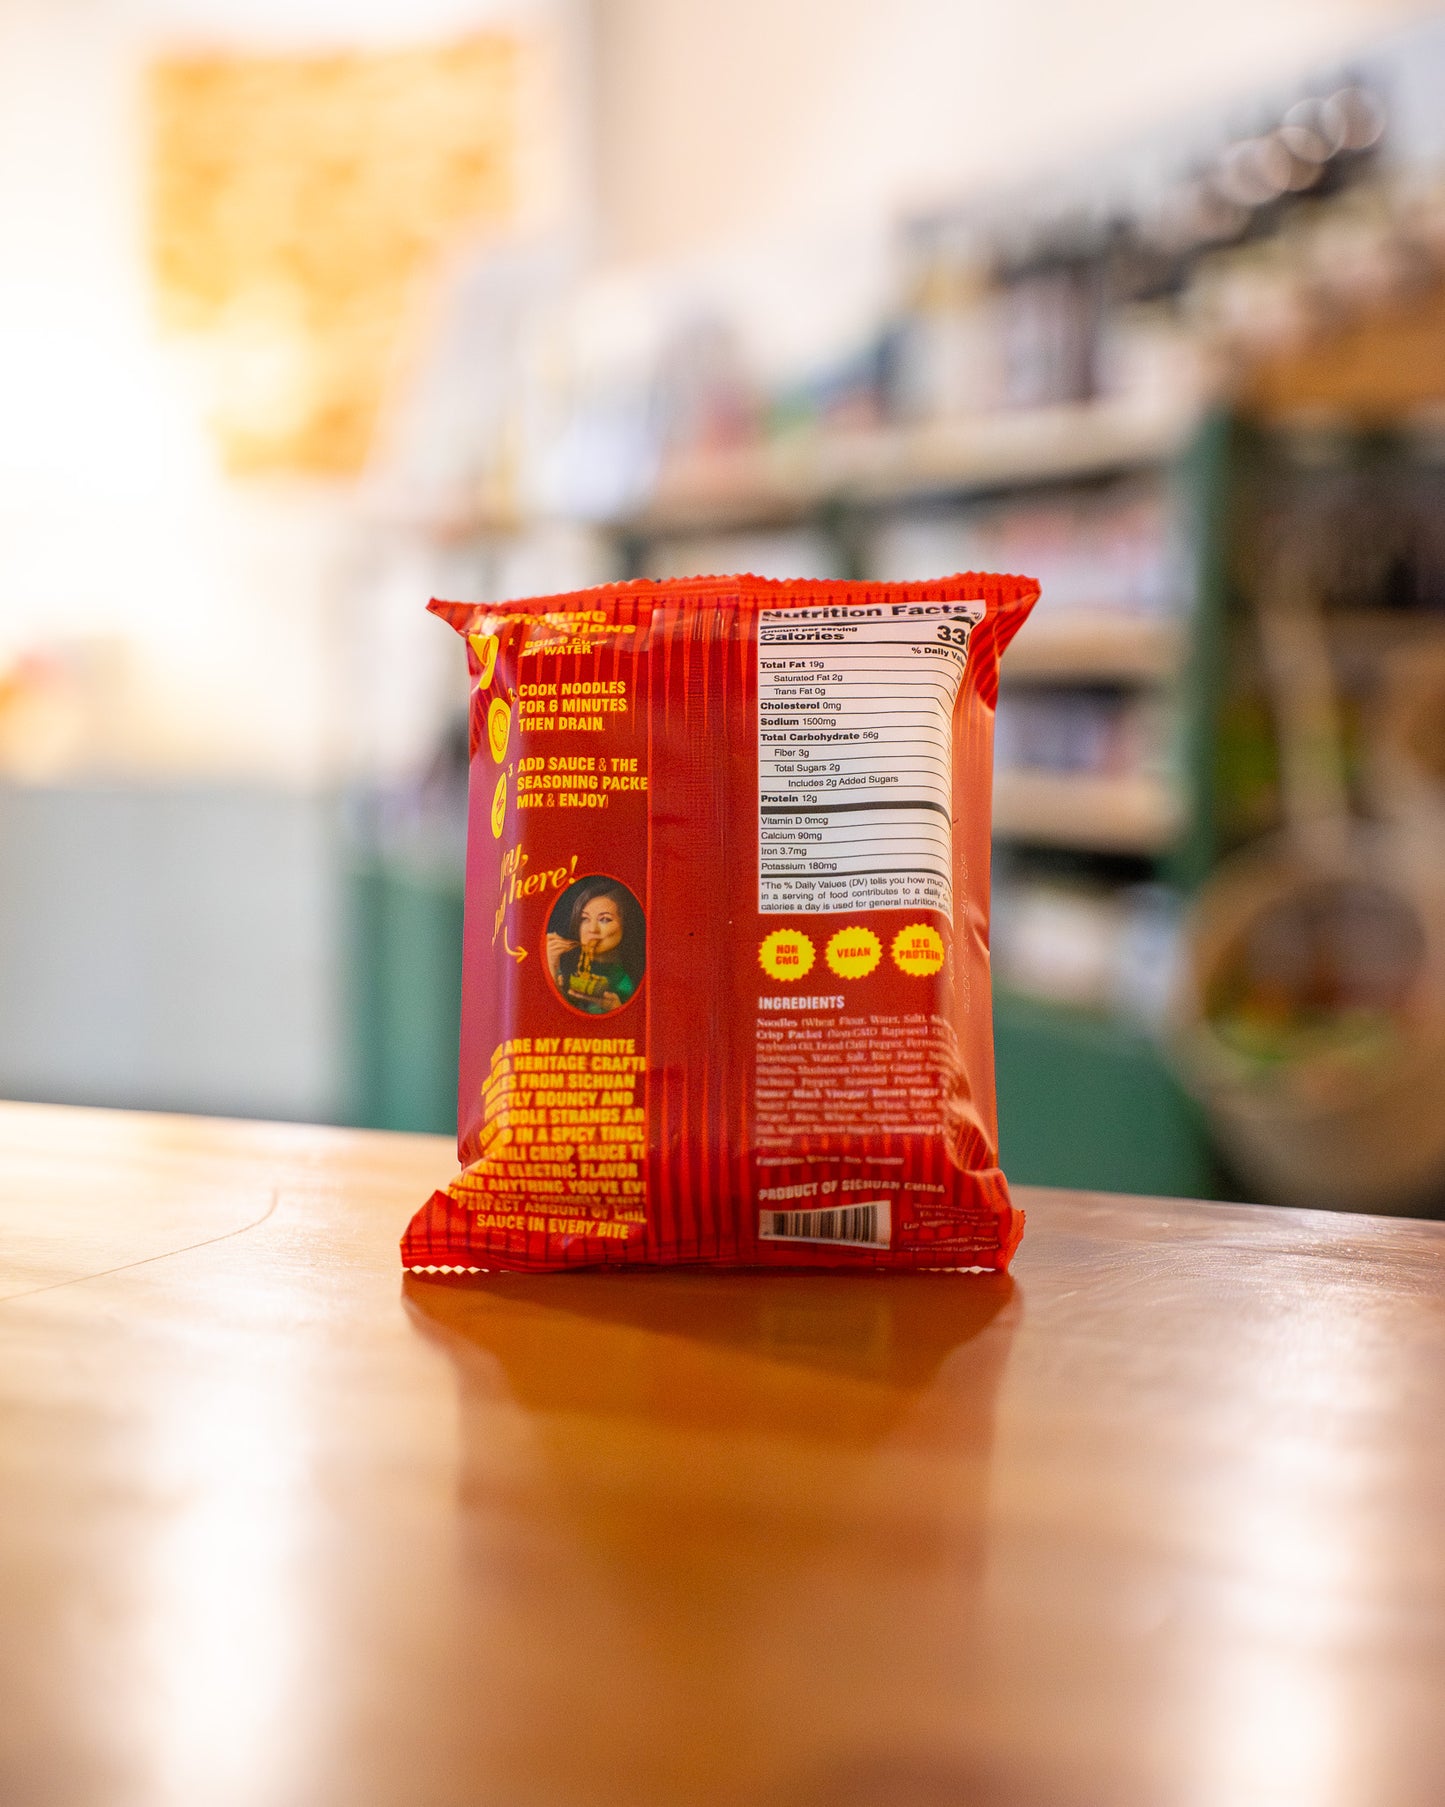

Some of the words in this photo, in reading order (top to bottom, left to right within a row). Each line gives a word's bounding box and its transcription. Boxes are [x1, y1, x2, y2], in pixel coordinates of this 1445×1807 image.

[762, 606, 882, 620] Nutrition
[892, 604, 967, 616] Facts
[761, 632, 844, 641] Calories
[924, 647, 949, 657] Daily
[832, 674, 843, 682] 2g
[518, 684, 557, 696] COOK
[561, 681, 626, 695] NOODLES
[815, 688, 826, 696] 0g
[519, 700, 545, 714] FOR
[549, 700, 558, 712] 6
[562, 698, 627, 712] MINUTES
[761, 702, 820, 710] Cholesterol
[823, 702, 841, 711] 0mg
[519, 718, 554, 731] THEN
[558, 717, 605, 731] DRAIN.
[803, 718, 836, 726] 1500mg
[790, 733, 859, 741] Carbohydrate
[863, 731, 878, 740] 56g
[775, 749, 796, 757] Fiber
[798, 749, 809, 758] 3g
[518, 758, 544, 773] ADD
[549, 757, 595, 771] SAUCE
[599, 758, 607, 771] &
[611, 759, 638, 772] THE
[775, 764, 795, 772] Total
[798, 764, 826, 773] Sugars
[829, 764, 840, 772] 2g
[517, 776, 598, 790] SEASONING
[788, 779, 824, 788] Includes
[826, 779, 837, 788] 2g
[839, 777, 866, 785] Added
[869, 776, 898, 785] Sugars
[517, 794, 543, 809] MIX
[546, 794, 555, 807] &
[761, 795, 798, 803] Protein
[802, 795, 817, 803] 12g
[805, 817, 828, 825] 0mcg
[761, 832, 795, 840] Calcium
[798, 832, 822, 841] 90mg
[761, 847, 777, 855] Iron
[780, 847, 807, 856] 3.7mg
[809, 862, 837, 871] 180mg
[795, 881, 816, 889] Daily
[849, 879, 868, 888] (DV)
[889, 878, 904, 886] you
[782, 891, 814, 901] serving
[818, 891, 826, 899] of
[852, 888, 899, 897] contributes
[903, 887, 911, 895] to
[805, 902, 820, 911] day
[833, 901, 853, 909] used
[856, 900, 867, 908] for
[869, 898, 901, 908] general
[904, 897, 937, 906] nutrition
[776, 945, 798, 954] NON
[837, 947, 871, 958] VEGAN
[899, 950, 940, 961] PROTEIN
[776, 956, 799, 965] GMO
[759, 995, 845, 1009] INGREDIENTS
[535, 1038, 561, 1052] MY
[563, 1038, 635, 1053] FAVORITE
[514, 1055, 585, 1071] HERITAGE
[520, 1074, 564, 1088] FROM
[569, 1074, 635, 1088] SICHUAN
[535, 1092, 597, 1106] BOUNCY
[601, 1092, 634, 1105] AND
[551, 1108, 620, 1124] STRANDS
[516, 1128, 534, 1142] IN
[537, 1127, 548, 1143] A
[551, 1127, 597, 1142] SPICY
[530, 1145, 575, 1160] CRISP
[578, 1145, 626, 1160] SAUCE
[507, 1164, 577, 1178] ELECTRIC
[580, 1163, 638, 1178] FLAVOR
[488, 1178, 565, 1193] ANYTHING
[569, 1180, 619, 1194] YOU'VE
[759, 1182, 818, 1201] PRODUCT
[821, 1180, 838, 1194] OF
[842, 1179, 900, 1191] SICHUAN
[904, 1182, 945, 1193] CHINA
[477, 1214, 524, 1230] SAUCE
[528, 1217, 545, 1231] IN
[548, 1219, 595, 1234] EVERY
[597, 1222, 629, 1239] BITE
